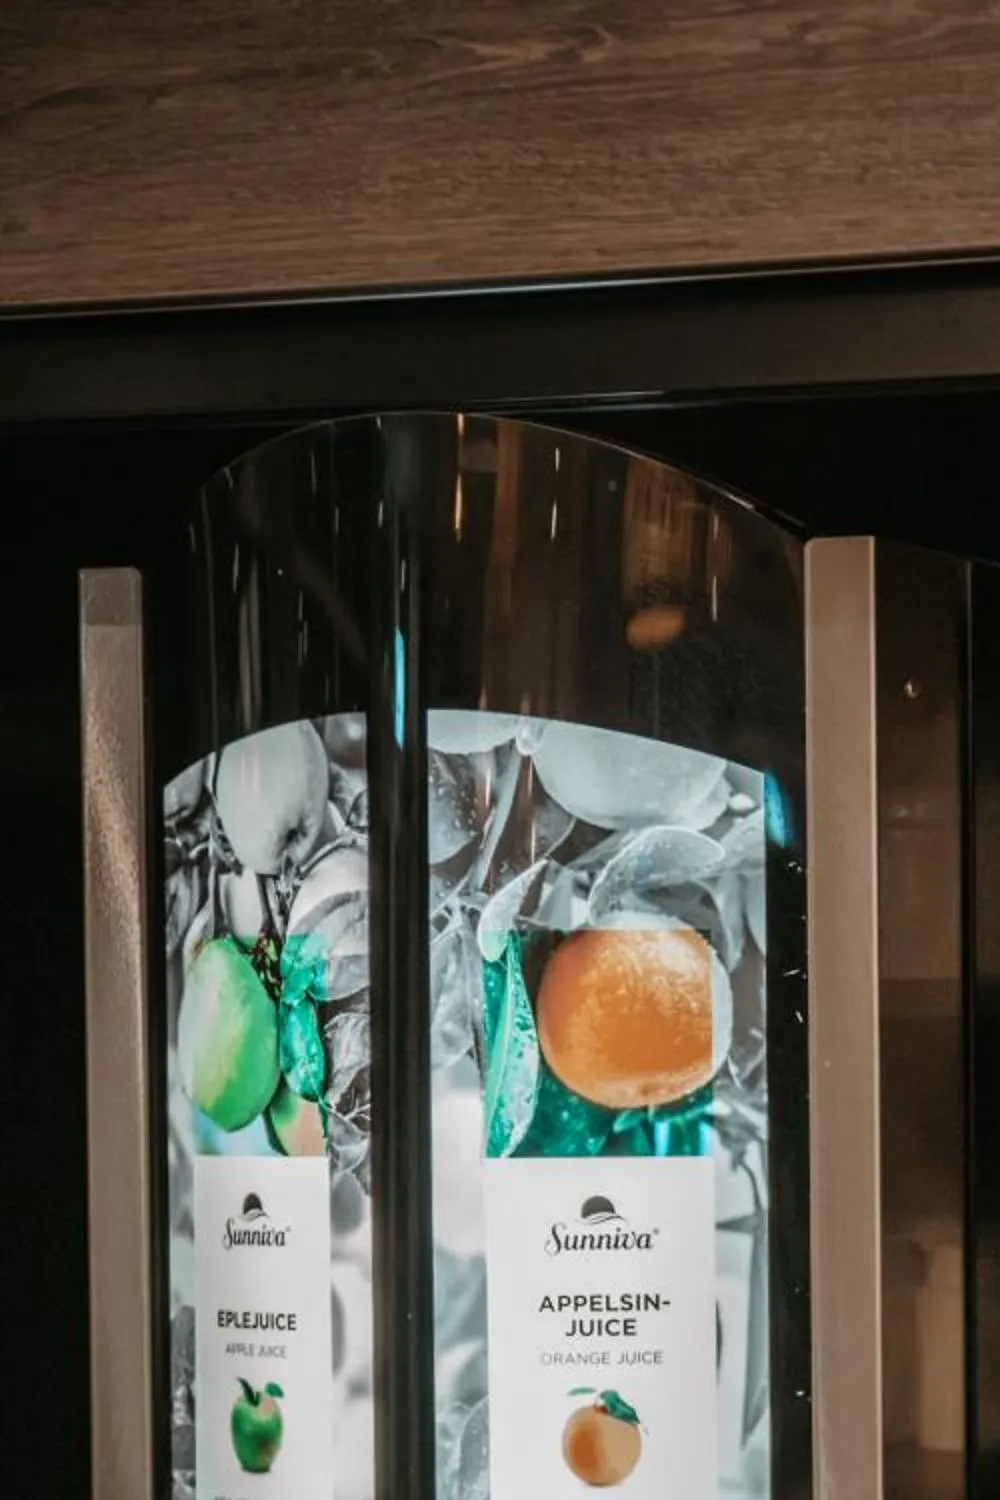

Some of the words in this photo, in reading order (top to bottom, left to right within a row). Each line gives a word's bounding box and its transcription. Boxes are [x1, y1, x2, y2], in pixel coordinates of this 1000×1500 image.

[222, 1218, 287, 1249] Sunniva
[544, 1222, 654, 1255] Sunniva
[538, 1293, 671, 1313] APPELSIN-
[217, 1309, 297, 1331] EPLEJUICE
[565, 1318, 638, 1338] JUICE
[540, 1350, 612, 1366] ORANGE
[616, 1350, 664, 1365] JUICE
